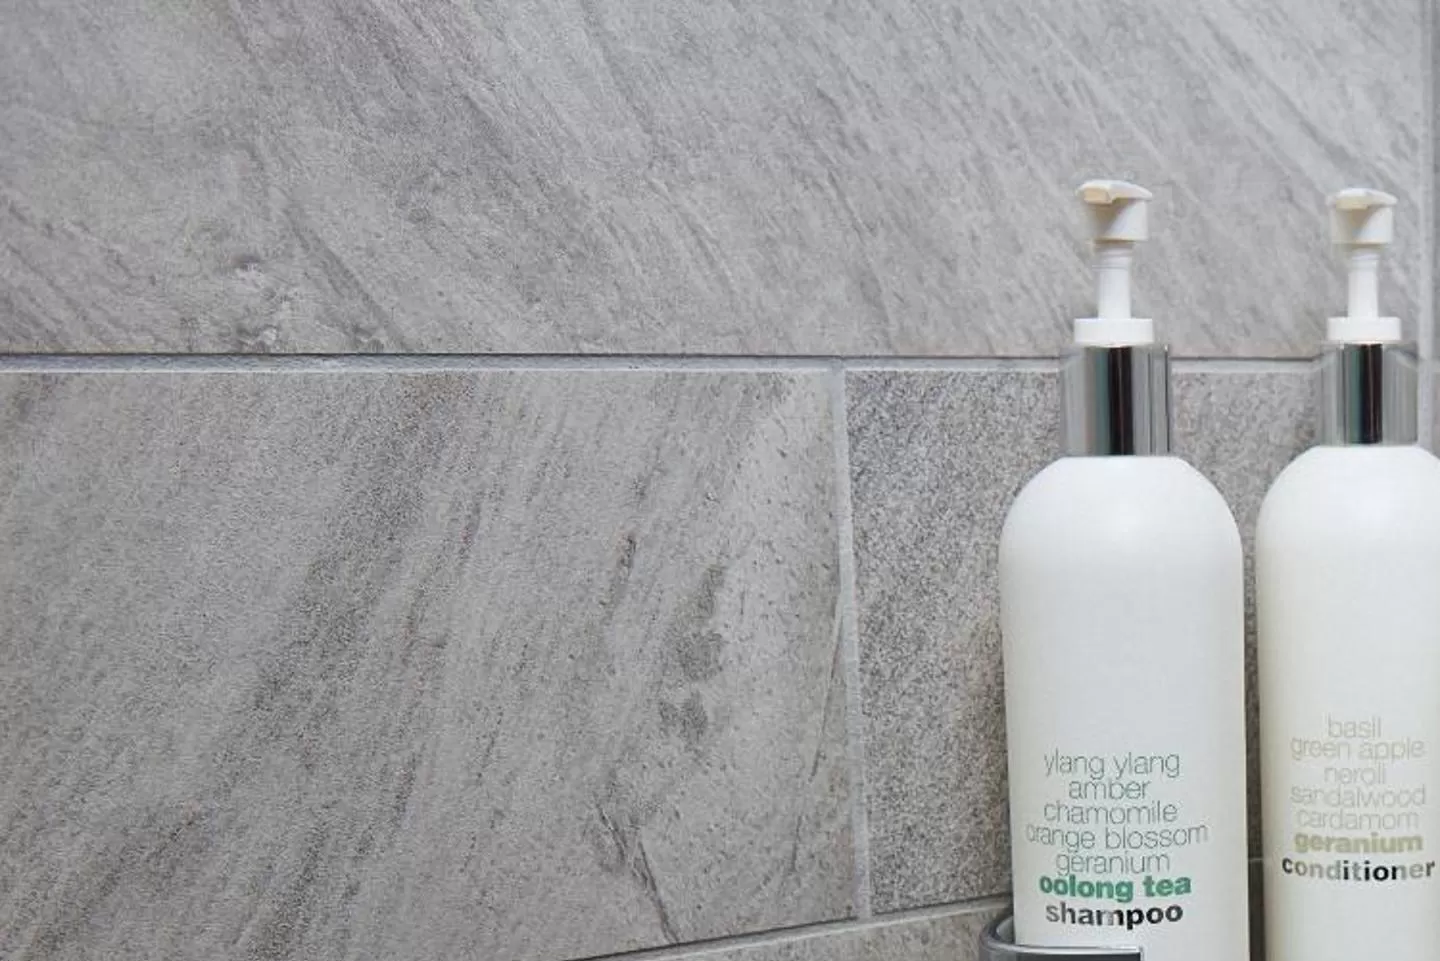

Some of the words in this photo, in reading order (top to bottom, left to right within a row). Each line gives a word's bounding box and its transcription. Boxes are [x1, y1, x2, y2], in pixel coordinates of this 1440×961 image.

[1327, 713, 1382, 739] basil
[1290, 737, 1351, 761] green
[1358, 738, 1426, 763] apple
[1043, 748, 1105, 780] ylang
[1113, 752, 1180, 780] ylang
[1068, 779, 1151, 800] amber
[1289, 784, 1427, 808] sandalwood
[1043, 800, 1178, 825] chamomile
[1025, 824, 1096, 852] orange
[1105, 824, 1210, 850] blossom
[1294, 832, 1424, 853] geranium
[1055, 850, 1170, 877] geranium
[1282, 857, 1436, 882] conditioner
[1039, 874, 1134, 903] oolong
[1143, 875, 1192, 898] tea
[1045, 901, 1184, 930] shampoo
